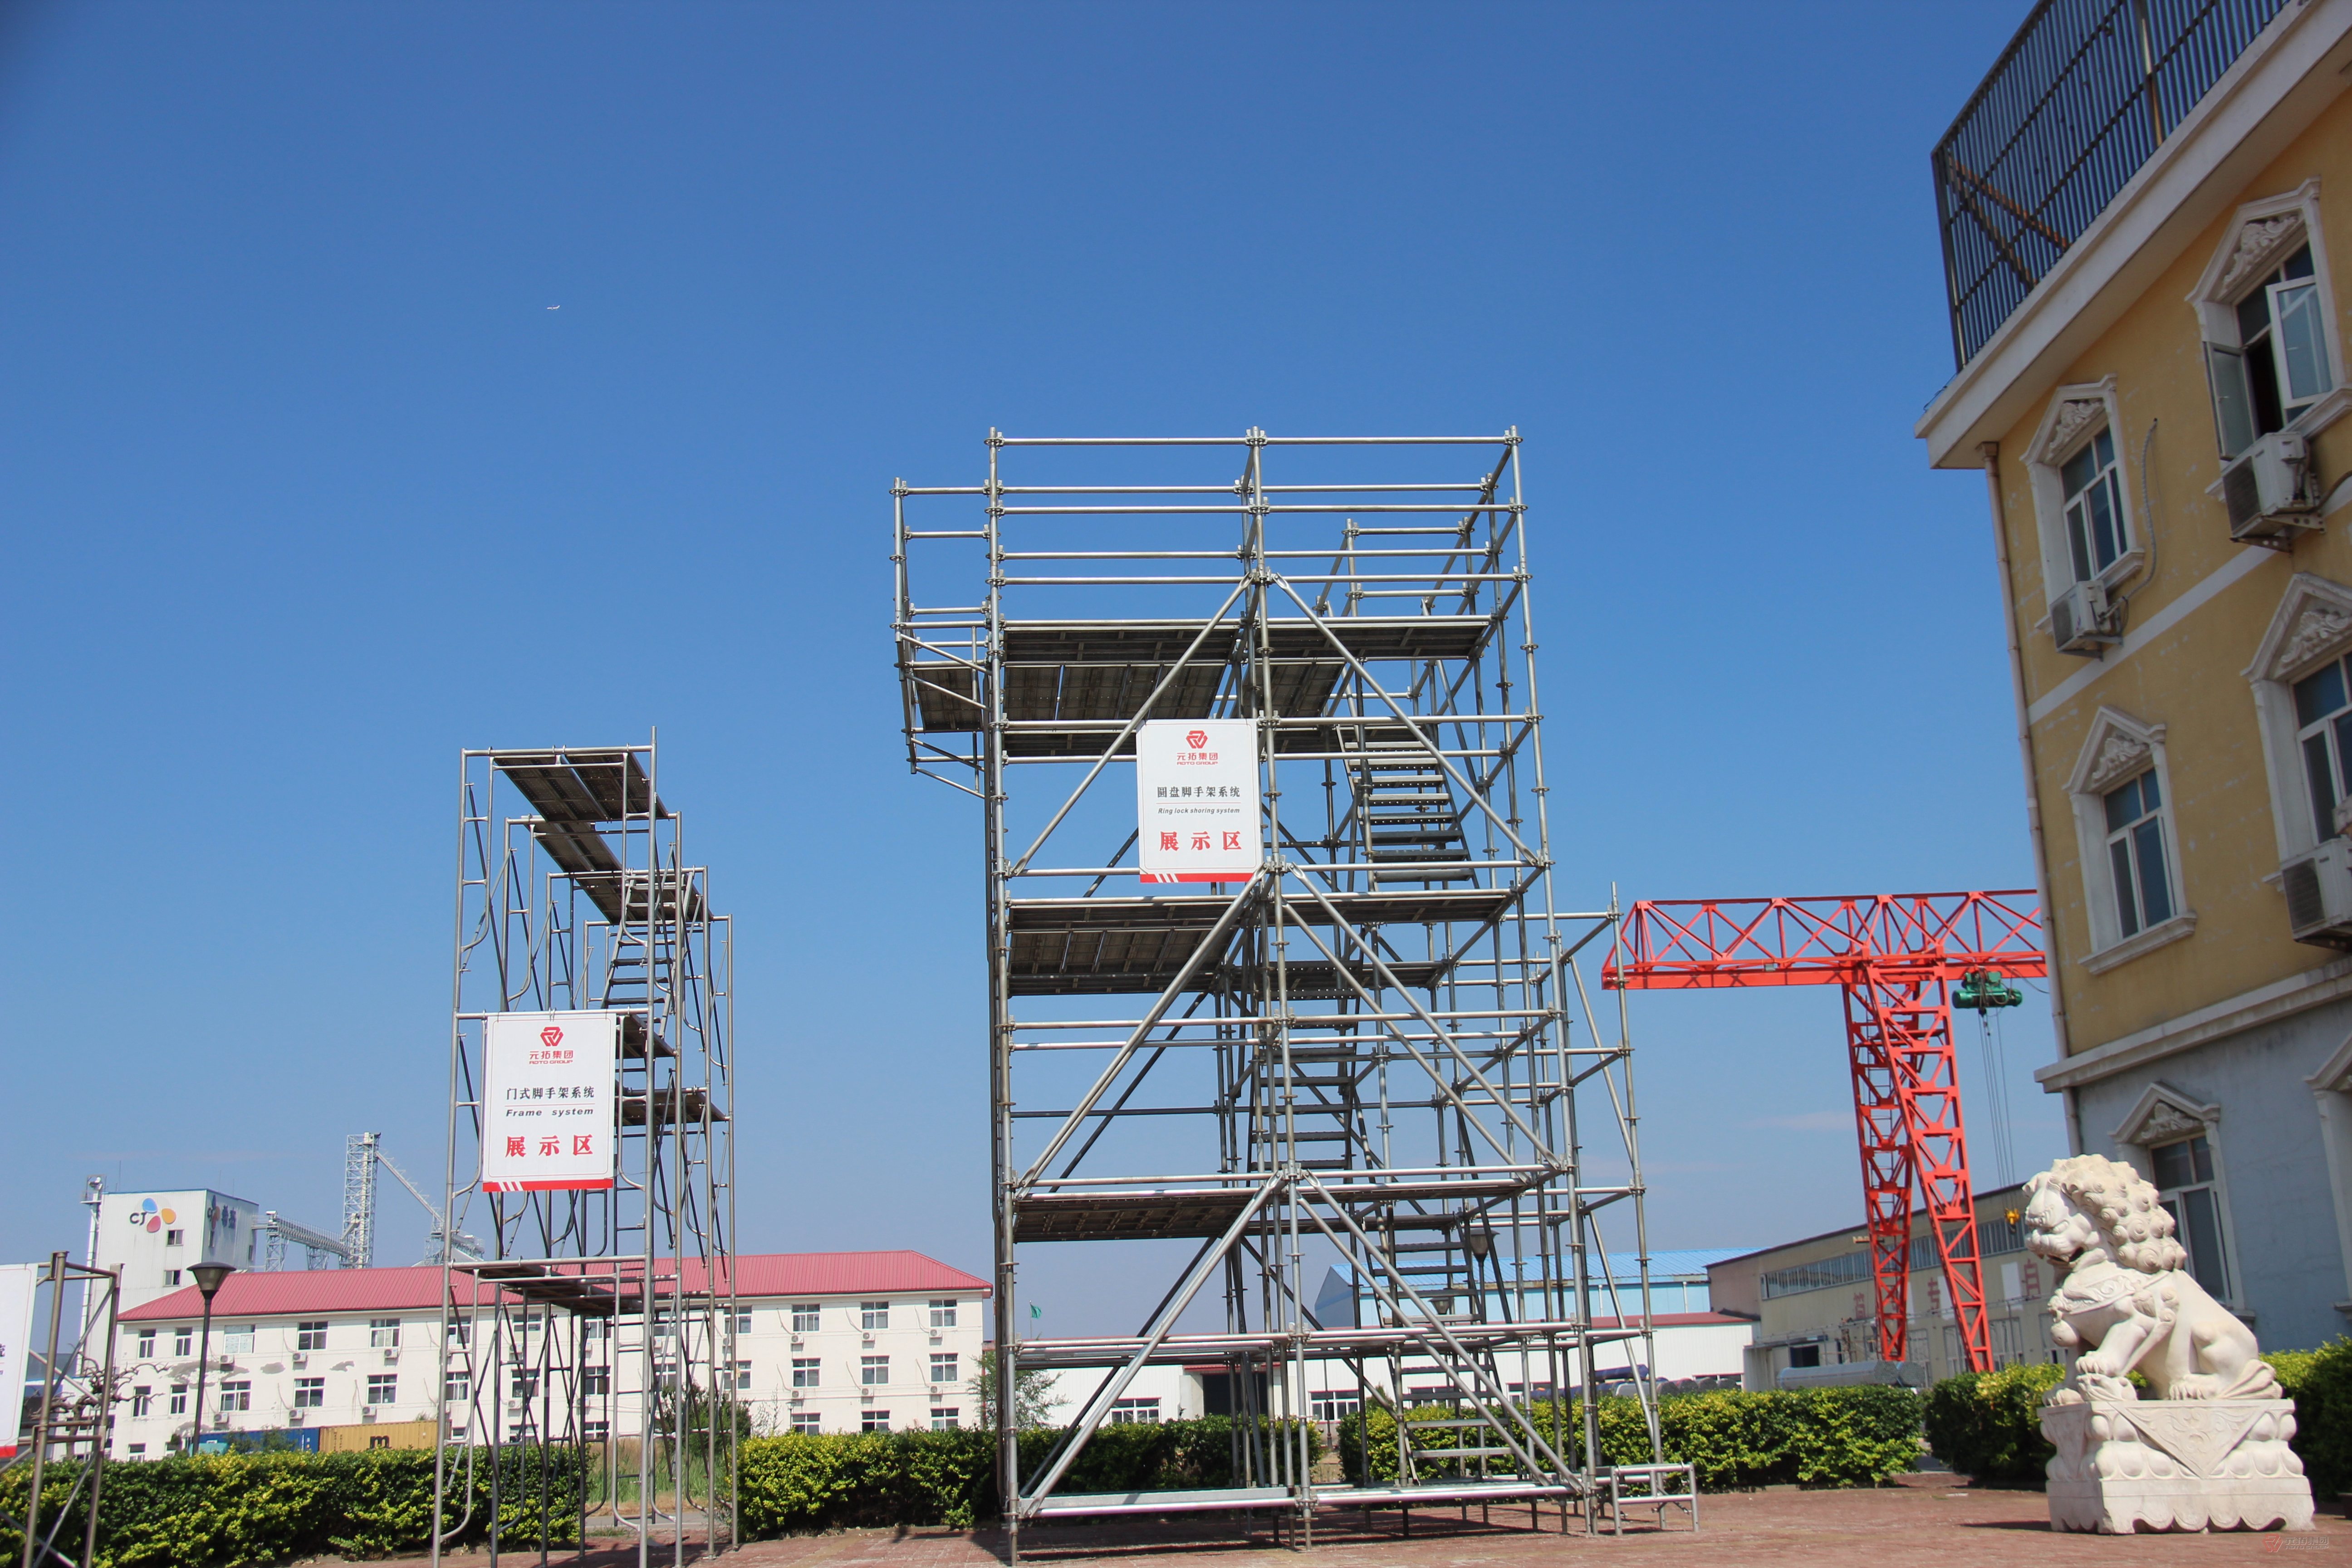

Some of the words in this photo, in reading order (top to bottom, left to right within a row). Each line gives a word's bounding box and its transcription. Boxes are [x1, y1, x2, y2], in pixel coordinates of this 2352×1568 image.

[1176, 752, 1218, 760] 元拓集团
[1157, 786, 1240, 798] 圆盘脚手架系统
[1159, 831, 1242, 852] 展示区
[529, 1050, 573, 1059] 元拓集团
[506, 1086, 595, 1100] 门式脚手架系统
[506, 1109, 542, 1117] Frame
[552, 1108, 593, 1117] system
[505, 1134, 593, 1158] 展示区
[130, 1211, 147, 1226] CJ
